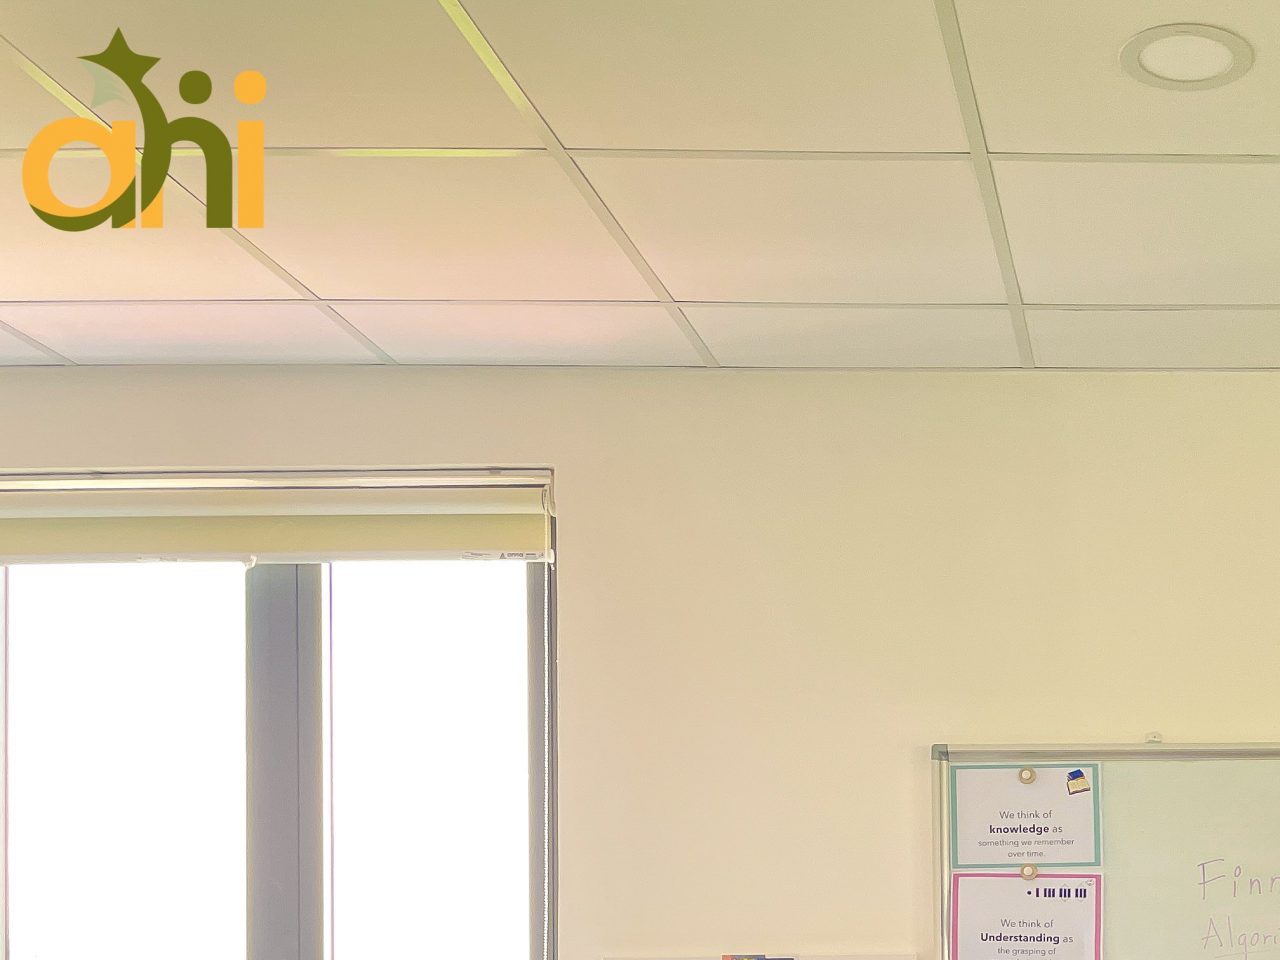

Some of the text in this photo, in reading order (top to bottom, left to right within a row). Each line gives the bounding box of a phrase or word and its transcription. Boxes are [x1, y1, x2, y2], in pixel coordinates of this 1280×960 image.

[1000, 810, 1052, 819] We think of
[989, 824, 1050, 835] knowledge
[978, 839, 1019, 848] something
[1034, 838, 1075, 846] remember
[1026, 850, 1046, 858] time.
[1000, 919, 1054, 928] We think of
[980, 932, 1060, 944] Understanding
[1012, 948, 1046, 956] grasping
[1048, 947, 1056, 955] of
